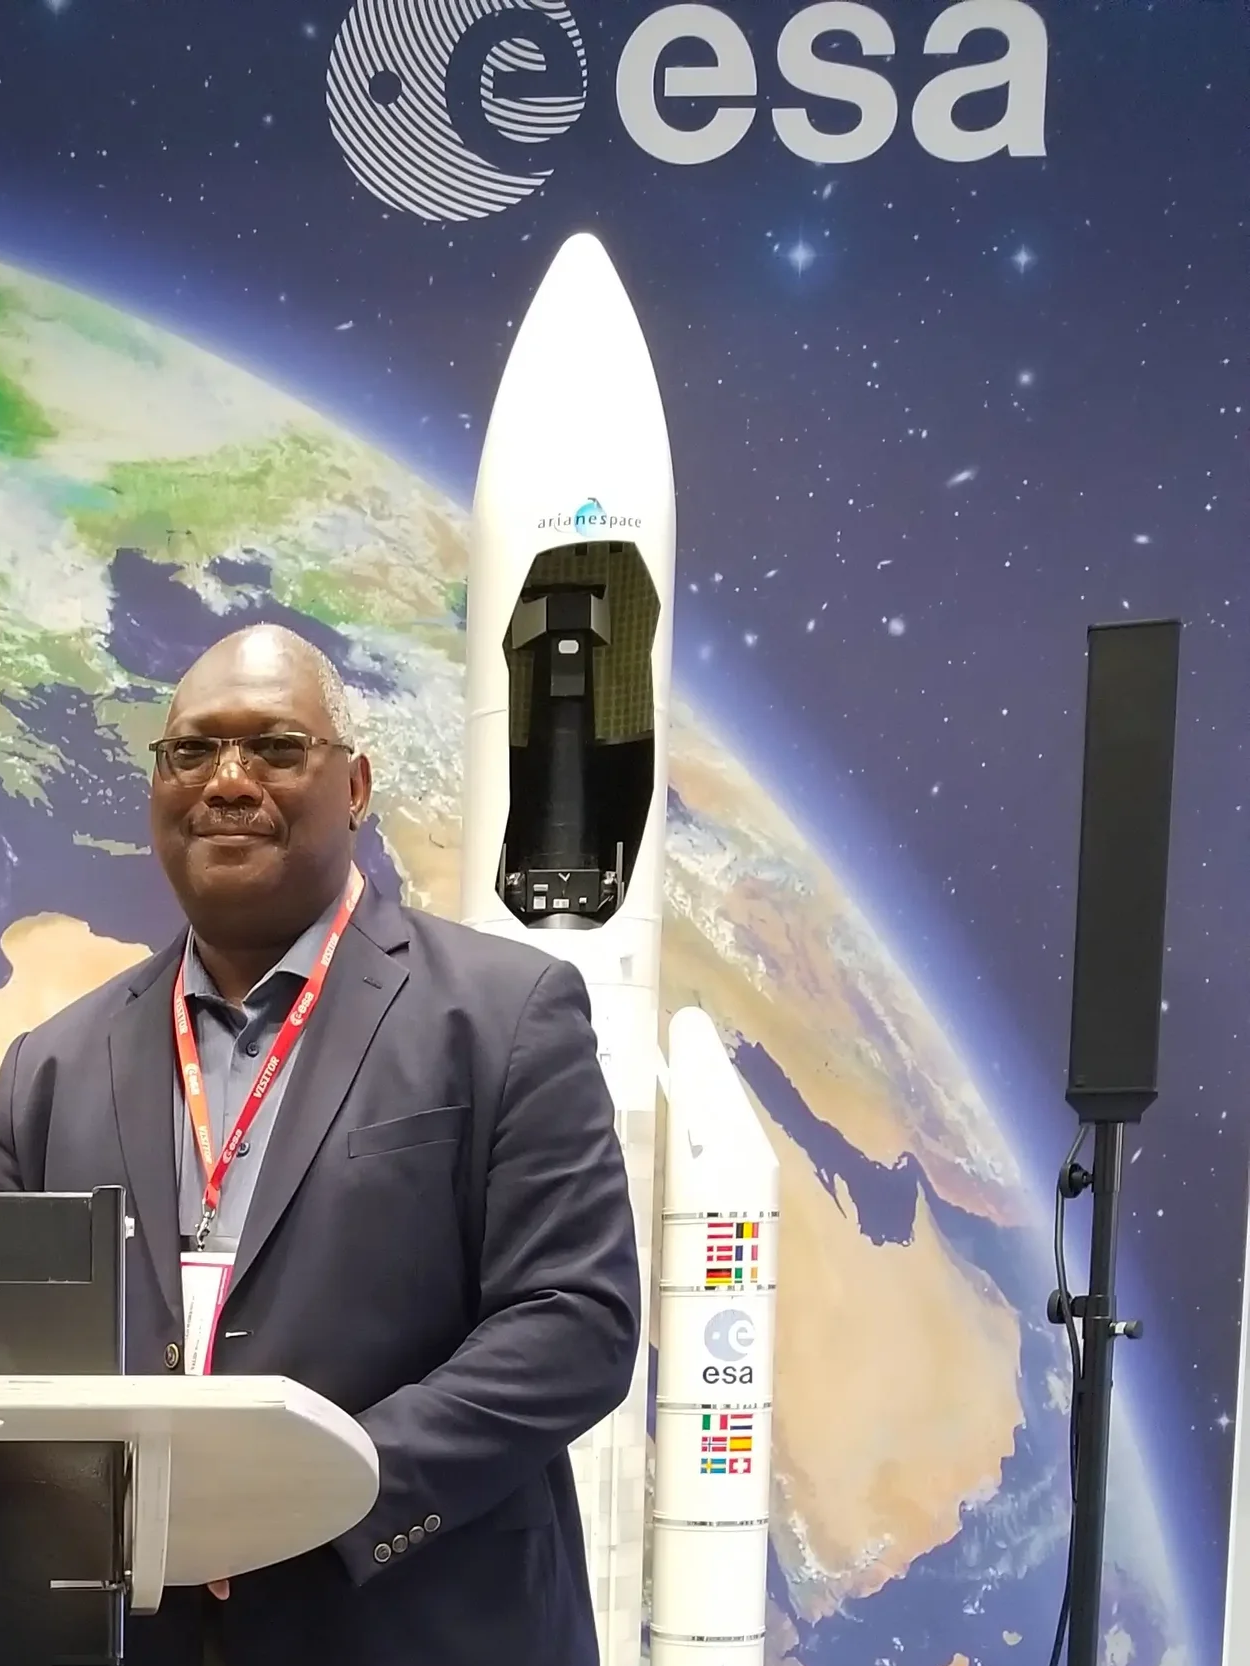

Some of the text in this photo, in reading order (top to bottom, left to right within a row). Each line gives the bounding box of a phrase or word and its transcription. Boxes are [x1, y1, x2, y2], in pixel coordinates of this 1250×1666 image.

[616, 1, 1048, 164] esa
[537, 512, 642, 529] arianespace
[253, 1055, 280, 1099] VISITOR
[702, 1366, 753, 1385] esa
